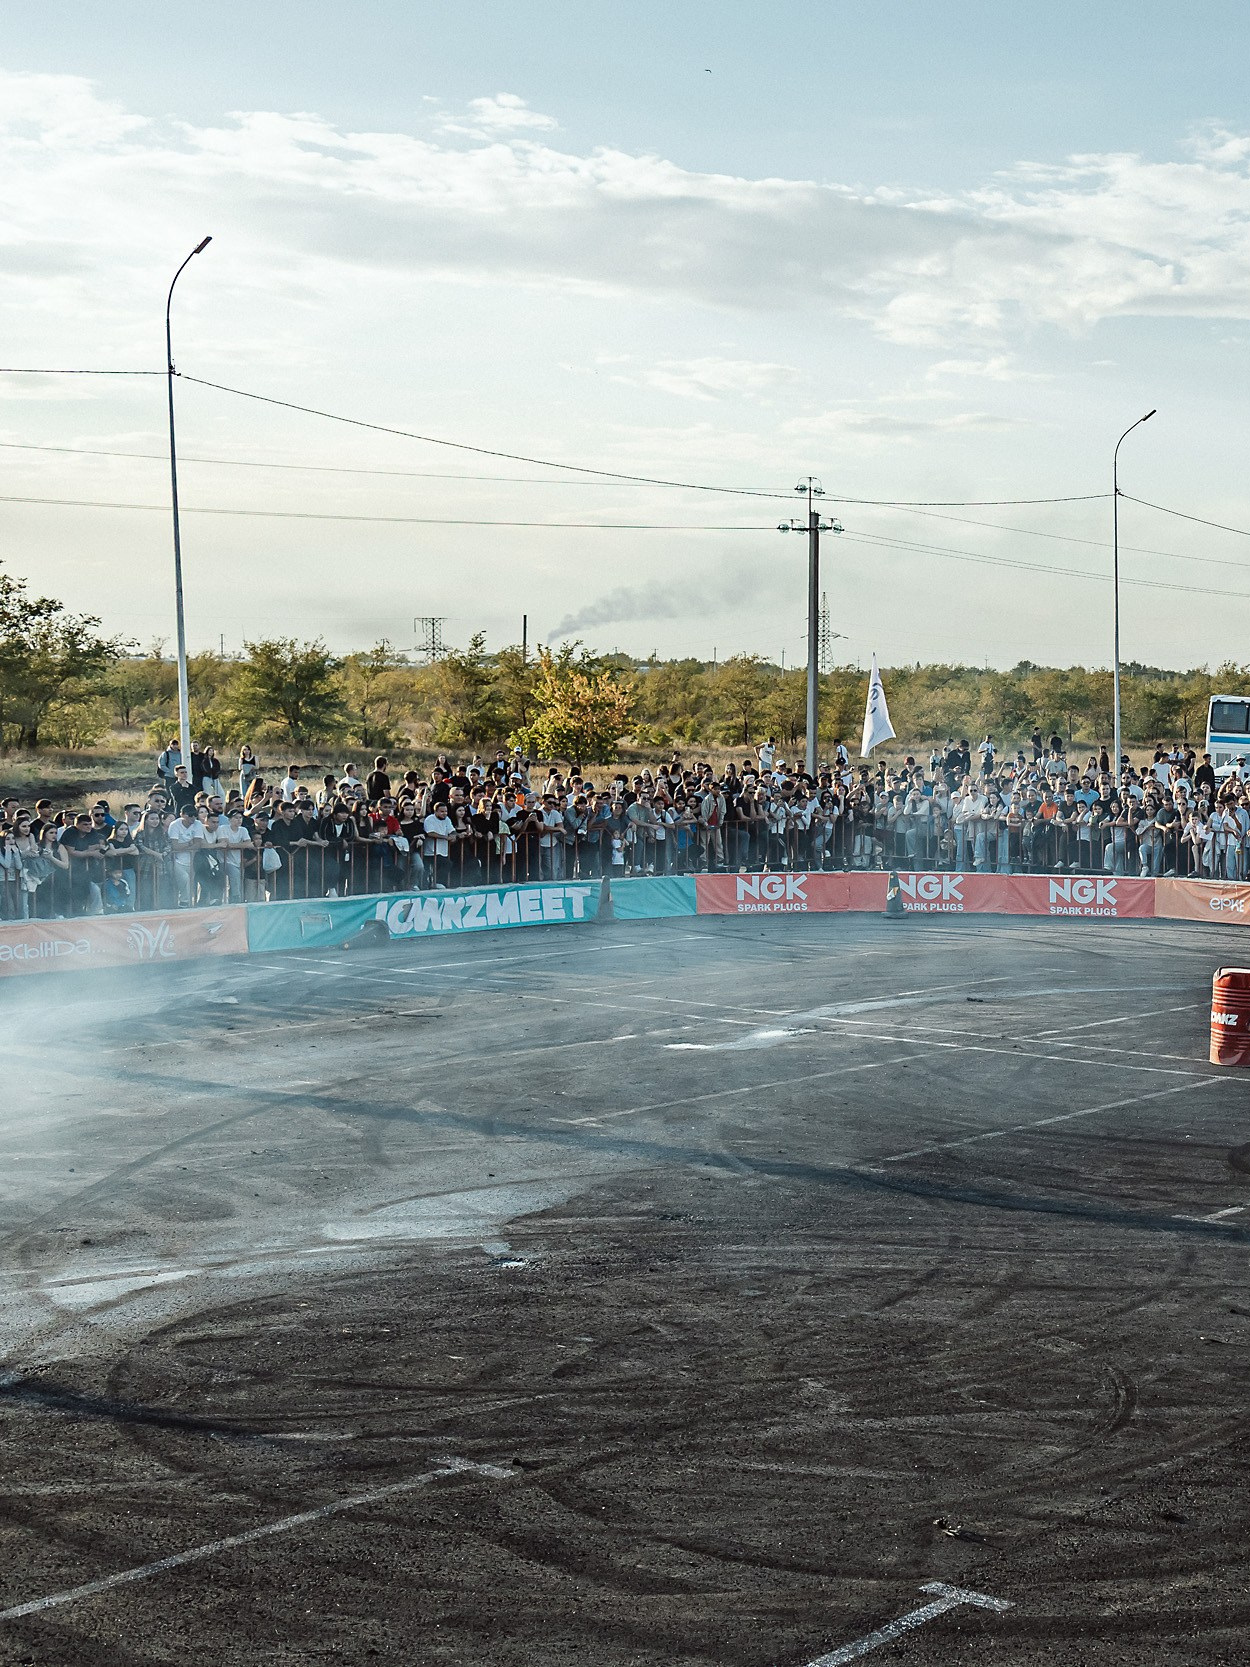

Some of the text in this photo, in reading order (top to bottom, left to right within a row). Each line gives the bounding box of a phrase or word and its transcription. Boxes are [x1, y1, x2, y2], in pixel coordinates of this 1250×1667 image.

[737, 874, 808, 901] NGK
[898, 874, 964, 901] NGK
[1049, 878, 1118, 906] NGK
[737, 902, 808, 912] SPARK PLUGS
[930, 903, 964, 911] PLUGS
[1050, 906, 1117, 916] SPARK PLUGS
